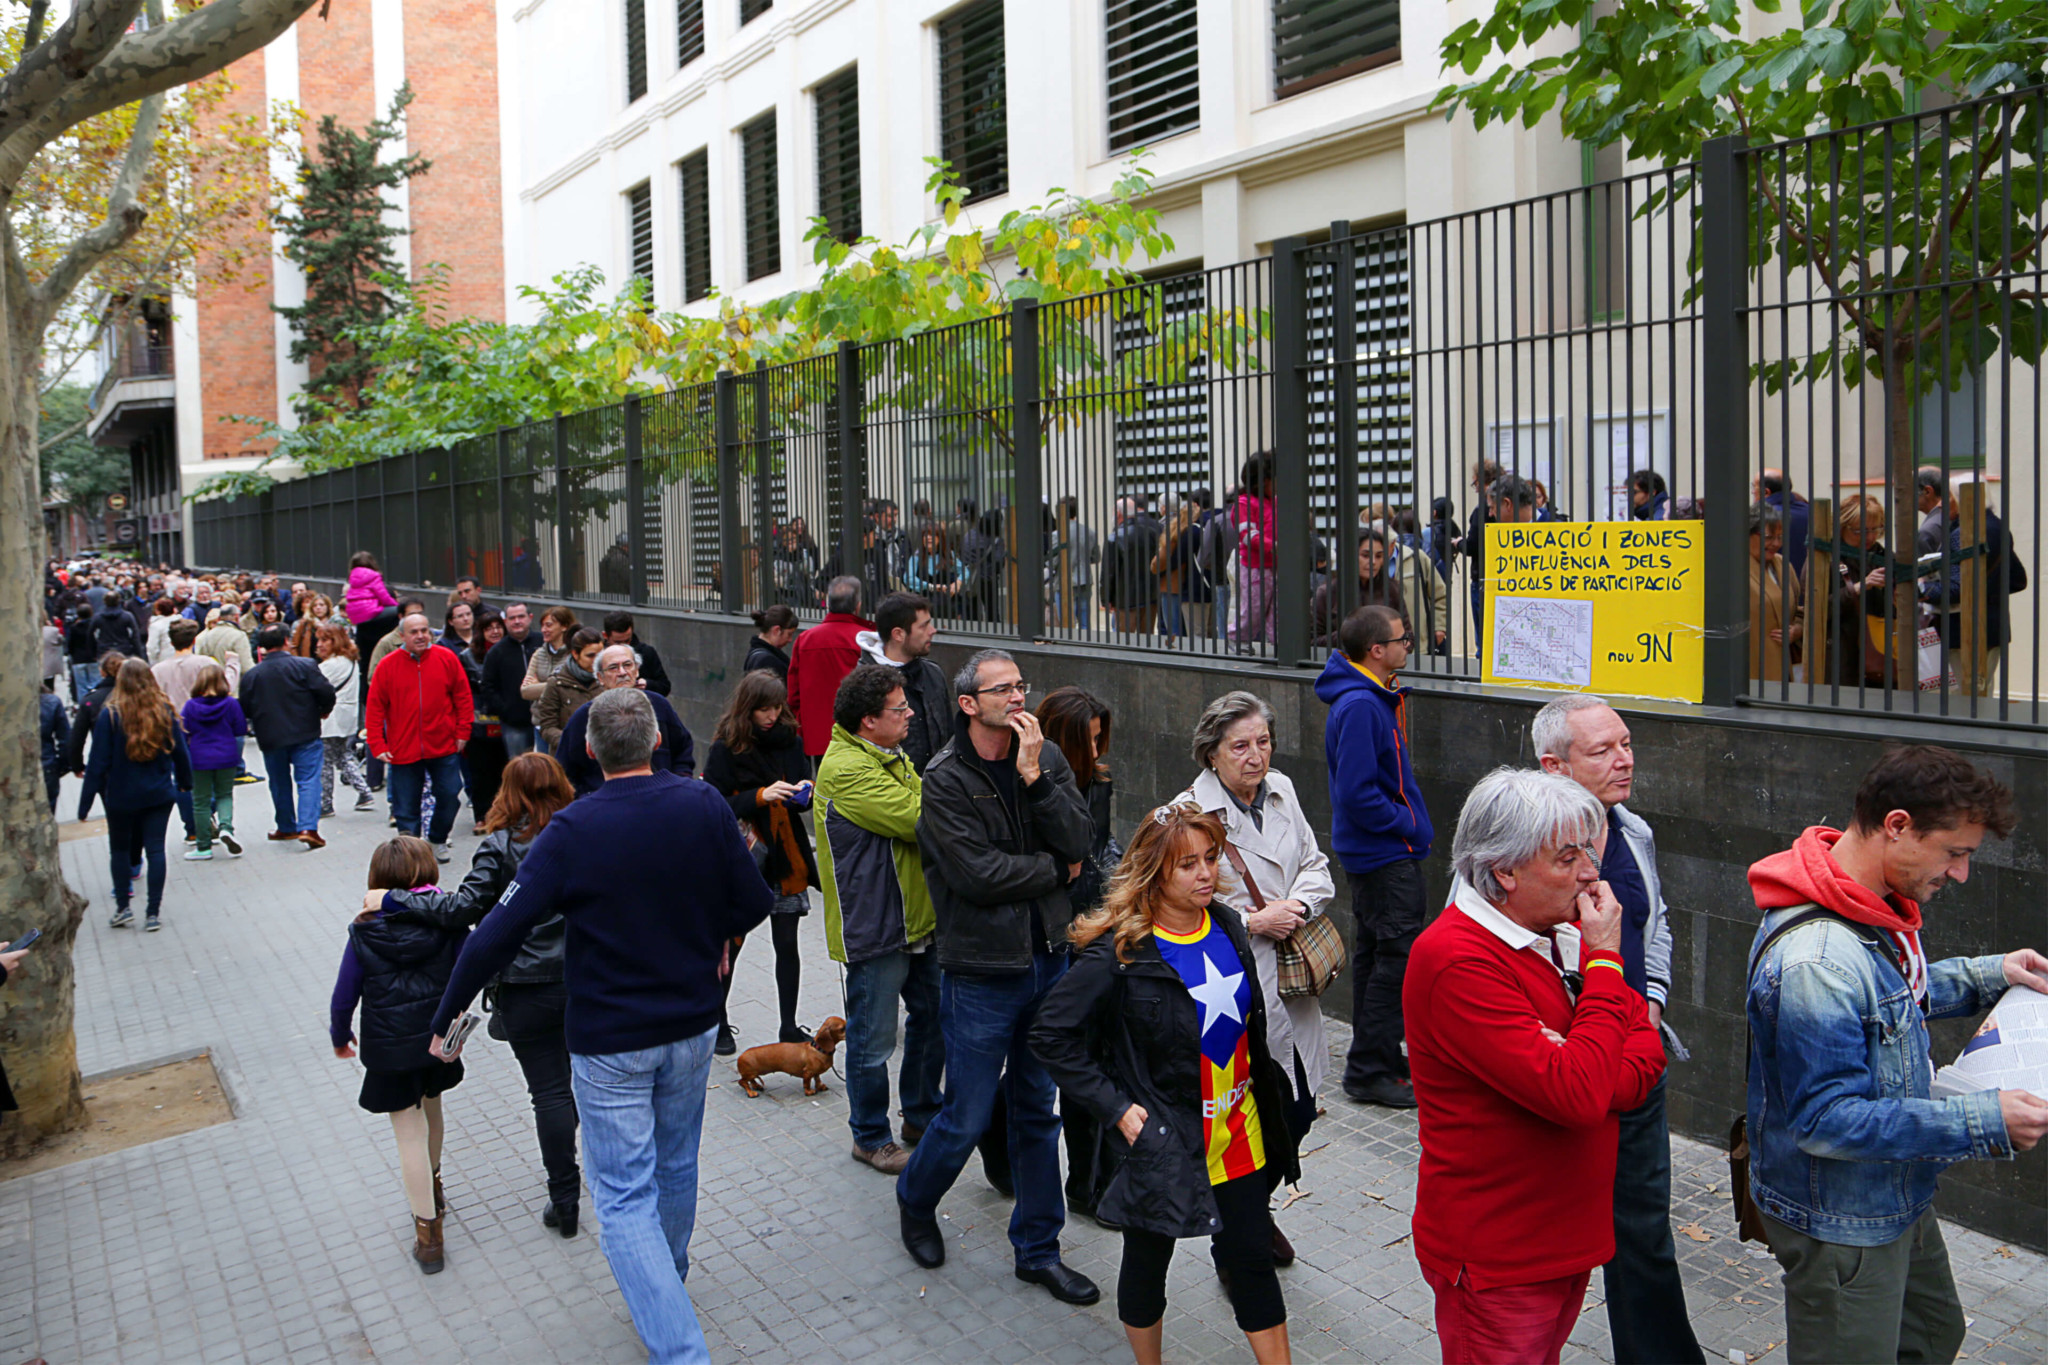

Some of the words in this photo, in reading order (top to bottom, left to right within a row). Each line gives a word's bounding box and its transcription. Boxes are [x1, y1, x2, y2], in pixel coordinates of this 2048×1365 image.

[1497, 524, 1593, 549] UBICACIÓ
[1603, 531, 1607, 549] I
[1619, 529, 1692, 549] ZONES
[1621, 553, 1672, 570] DELS
[1497, 576, 1553, 592] LOCALS
[1560, 575, 1578, 592] DE
[1583, 568, 1690, 592] PARTICIPACIÓ
[1608, 651, 1634, 663] nou
[1636, 631, 1673, 663] 9N
